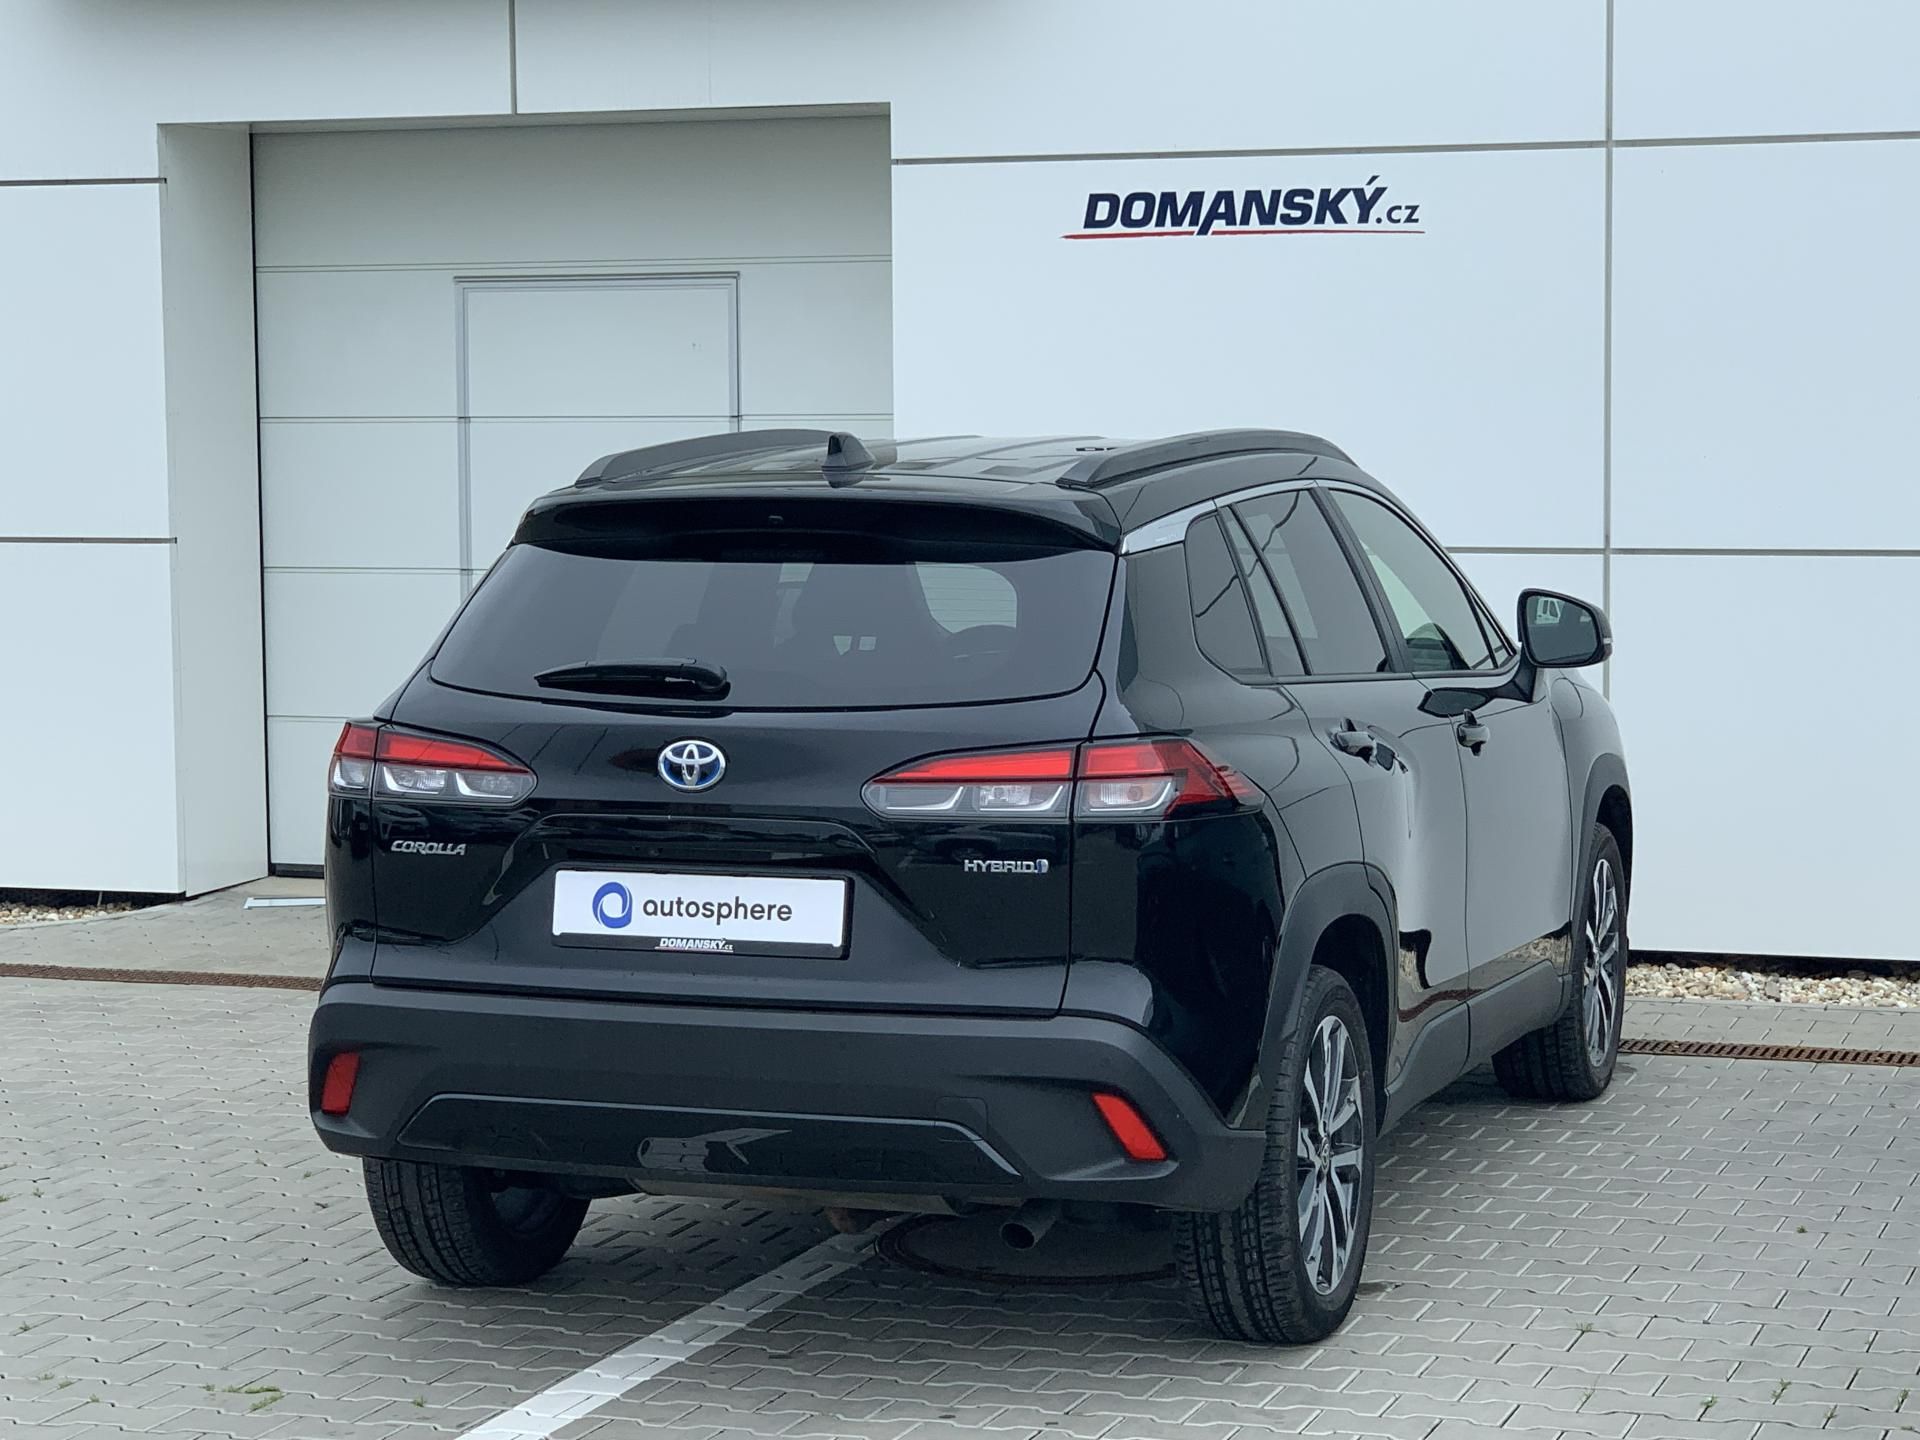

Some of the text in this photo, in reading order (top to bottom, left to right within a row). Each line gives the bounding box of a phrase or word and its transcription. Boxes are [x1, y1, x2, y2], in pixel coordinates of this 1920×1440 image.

[390, 840, 467, 855] COROLLA
[963, 859, 1035, 873] HYBRID
[643, 896, 793, 926] autosphere
